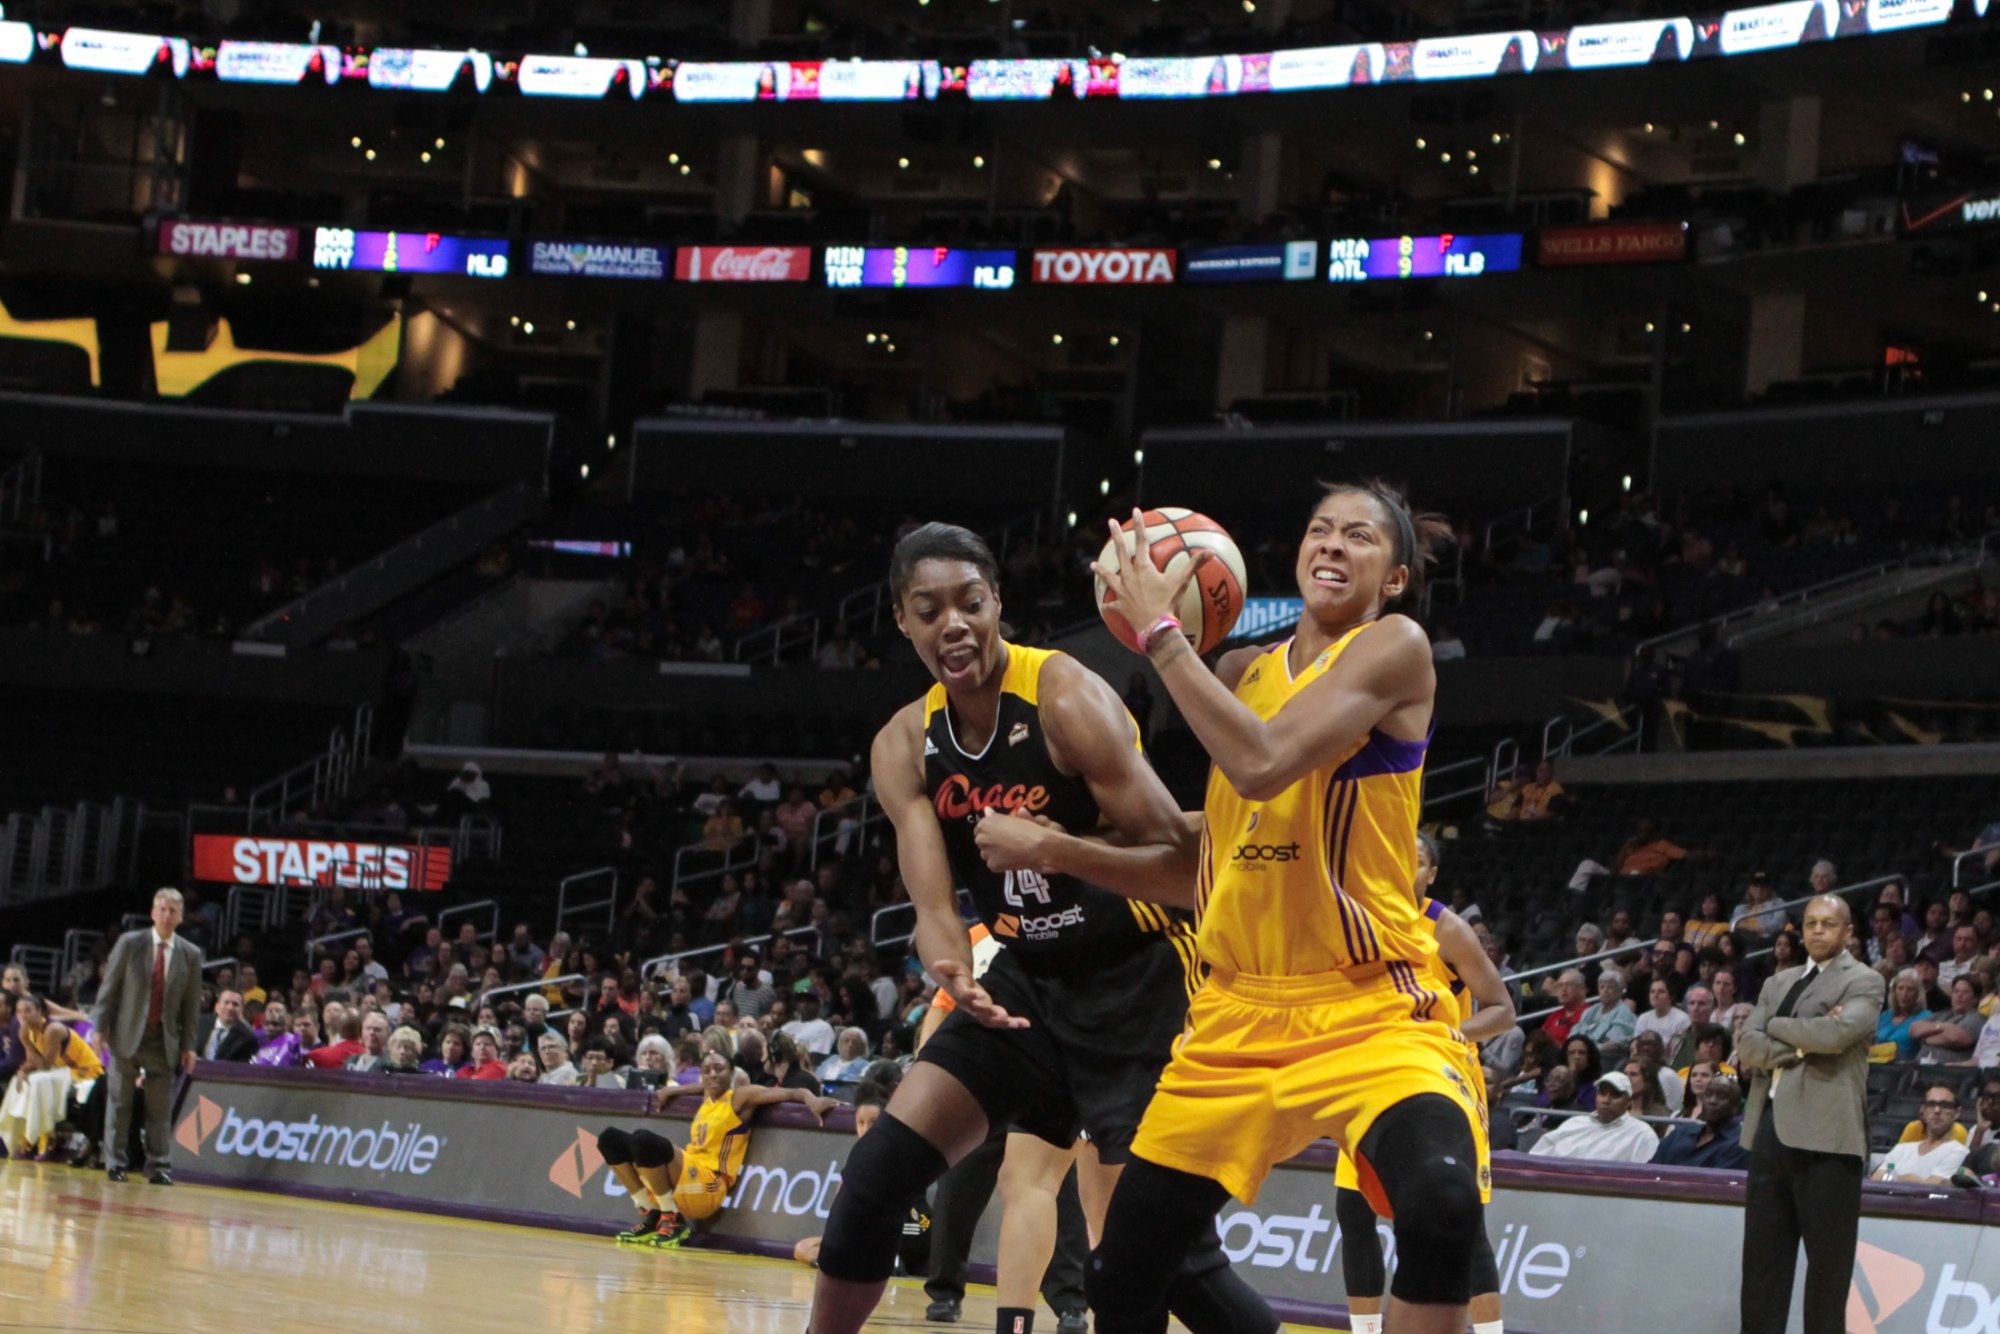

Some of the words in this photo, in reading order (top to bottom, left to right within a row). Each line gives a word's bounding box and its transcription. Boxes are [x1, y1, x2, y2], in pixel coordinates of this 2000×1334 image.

[171, 224, 288, 259] STAPLES
[425, 232, 441, 254] F
[533, 242, 571, 262] SAN
[586, 244, 662, 265] MANUEL
[1330, 238, 1370, 259] MIA
[1440, 233, 1454, 254] F
[1543, 236, 1612, 254] WELLS
[1617, 232, 1685, 251] FARGO
[466, 253, 508, 278] MLB
[825, 246, 865, 267] MIN
[932, 247, 948, 267] F
[1033, 252, 1174, 282] TOYOTA
[1329, 259, 1368, 282] ATL
[1445, 251, 1485, 276] MLB
[825, 266, 863, 287] TOR
[892, 266, 907, 287] 9
[973, 265, 1014, 289] MLB
[232, 838, 410, 890] STAPLES
[1020, 903, 1085, 932] boost
[1026, 929, 1059, 940] mobile
